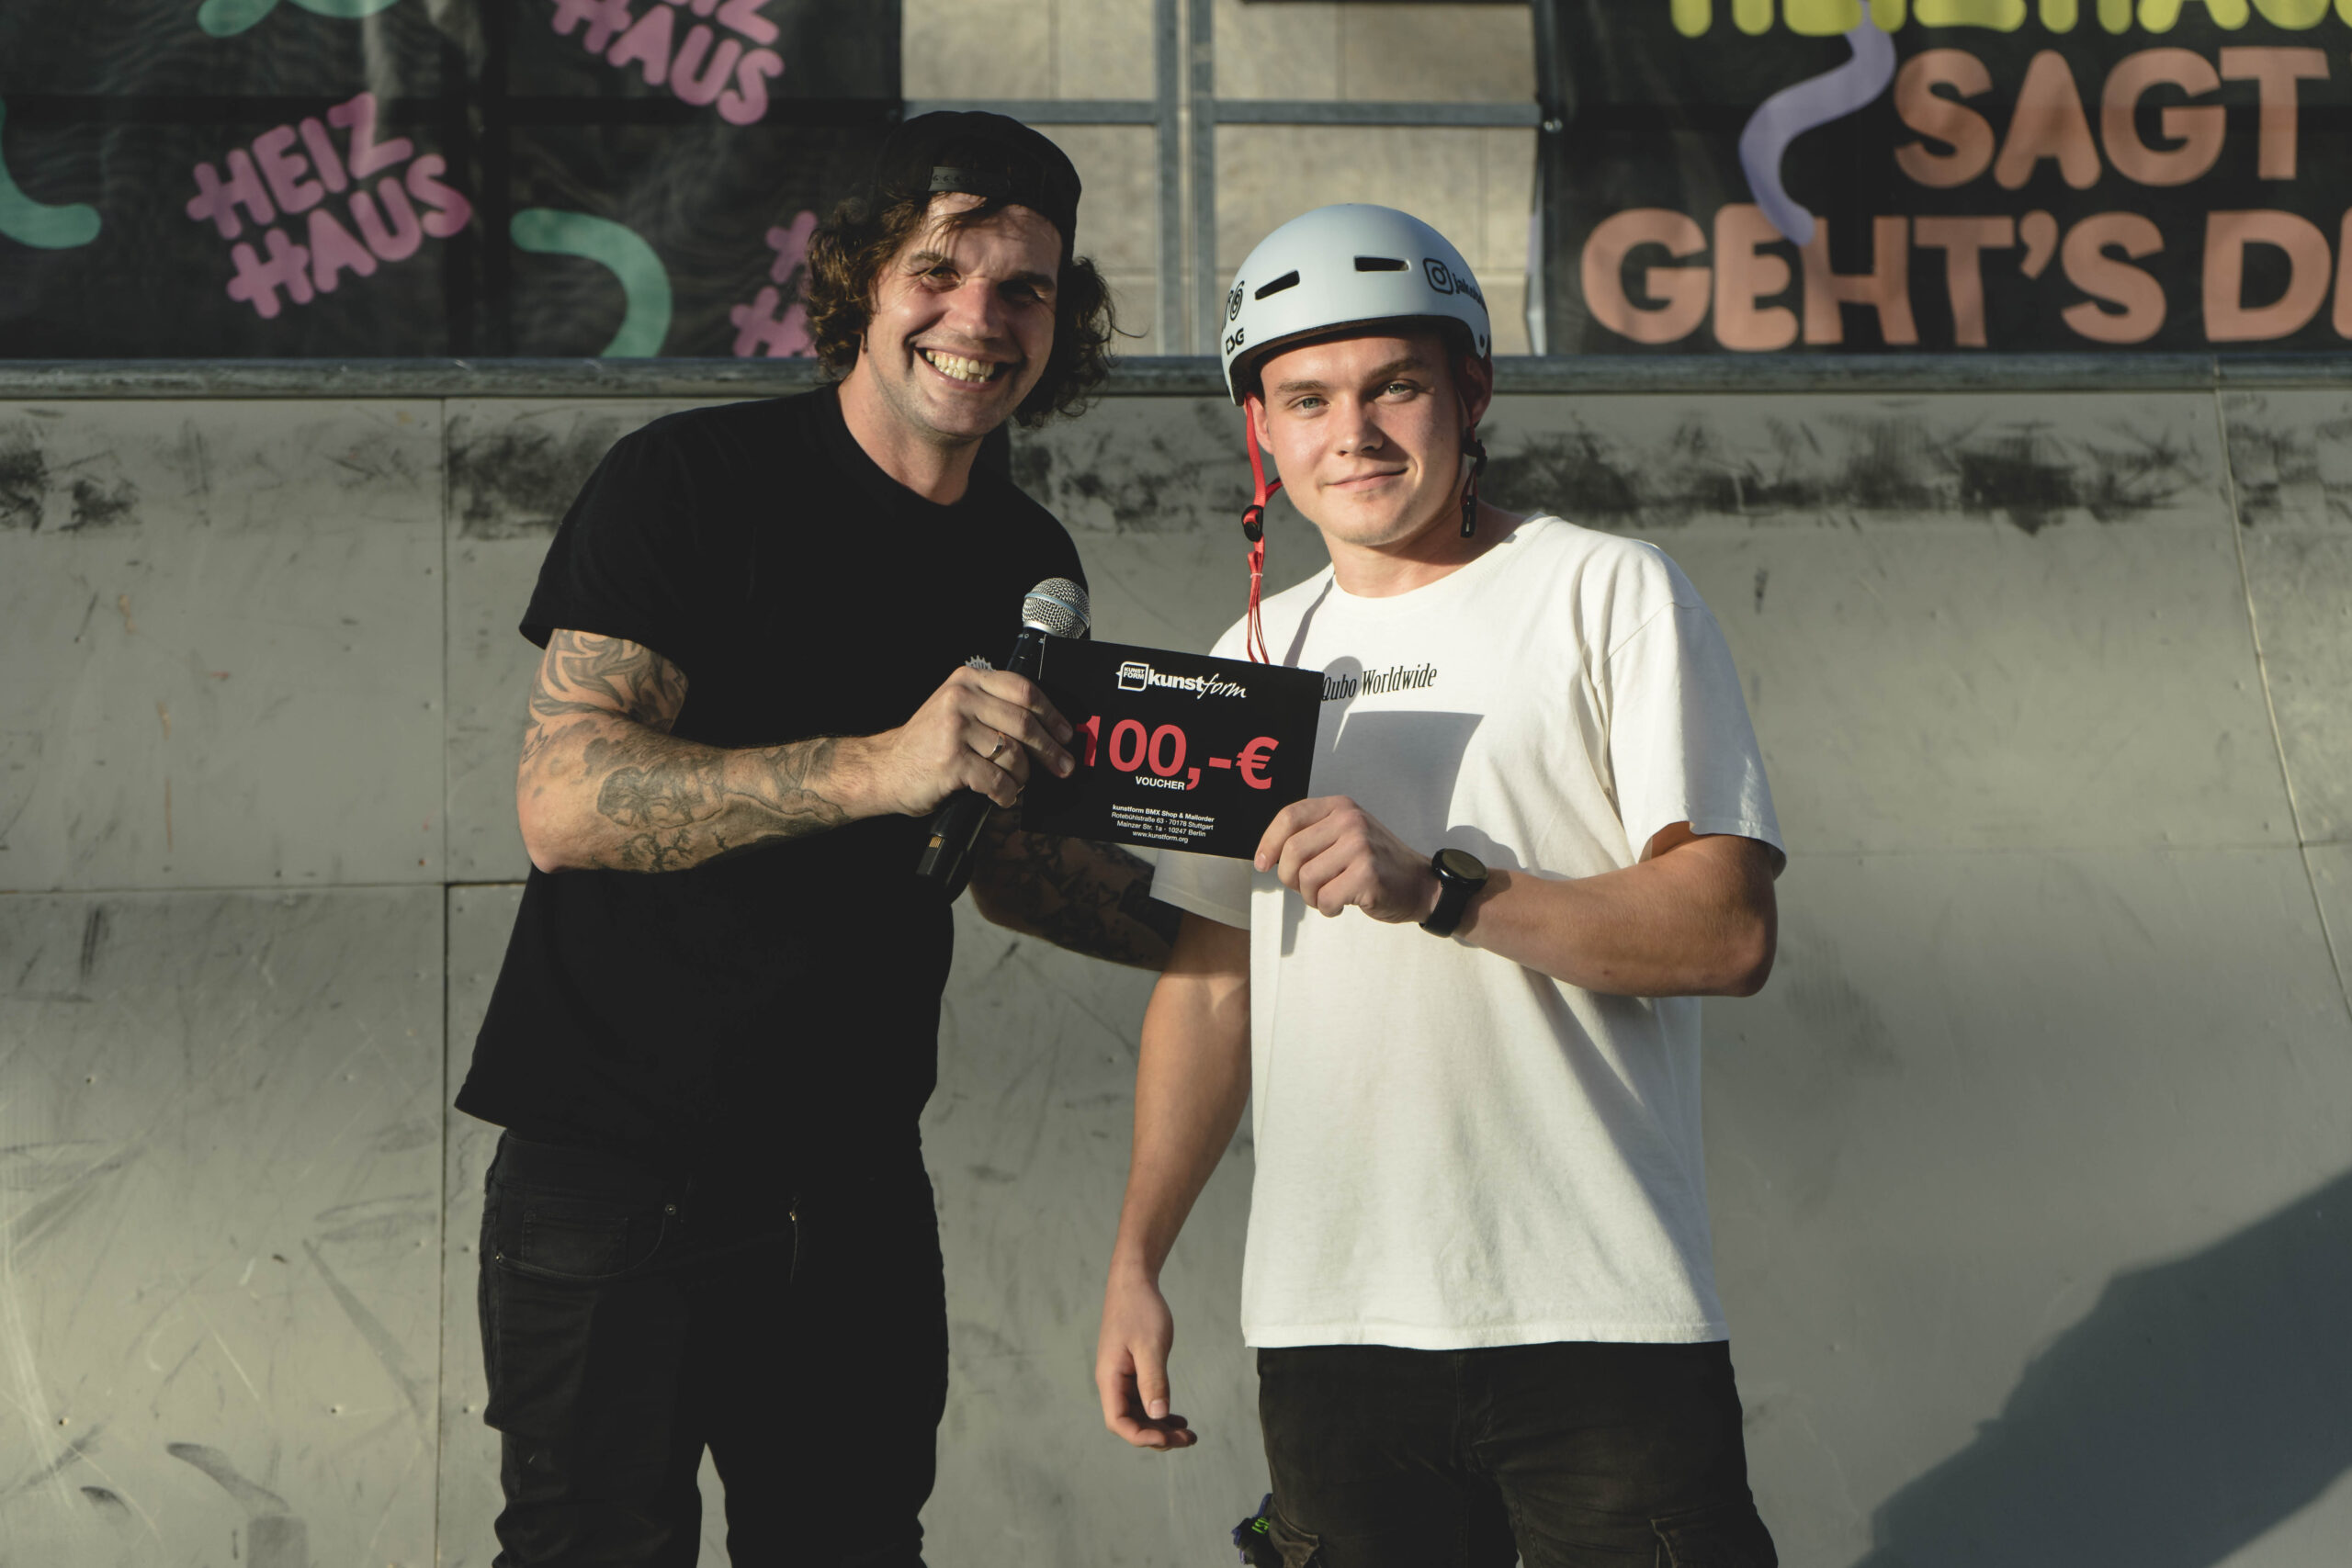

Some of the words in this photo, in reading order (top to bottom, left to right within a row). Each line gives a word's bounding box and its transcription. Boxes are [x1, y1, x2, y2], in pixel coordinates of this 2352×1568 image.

[1894, 46, 2330, 189] SAGT
[187, 92, 413, 241] HEIZ
[227, 153, 472, 320] HAUS
[1580, 204, 2166, 352] GEHT'S
[2202, 208, 2352, 342] D
[1123, 671, 1145, 680] FORM
[1362, 662, 1438, 696] Worldwide
[1135, 775, 1185, 791] VOUCHER
[1112, 804, 1145, 814] kunstform
[1161, 810, 1178, 818] Shop
[1184, 813, 1215, 823] Mailorder
[1116, 820, 1141, 829] Mainzer
[1168, 827, 1187, 835] 10247
[1188, 829, 1206, 837] Berlin
[1188, 821, 1214, 830] Stuttgart
[1132, 830, 1189, 844] www.kunstform.org
